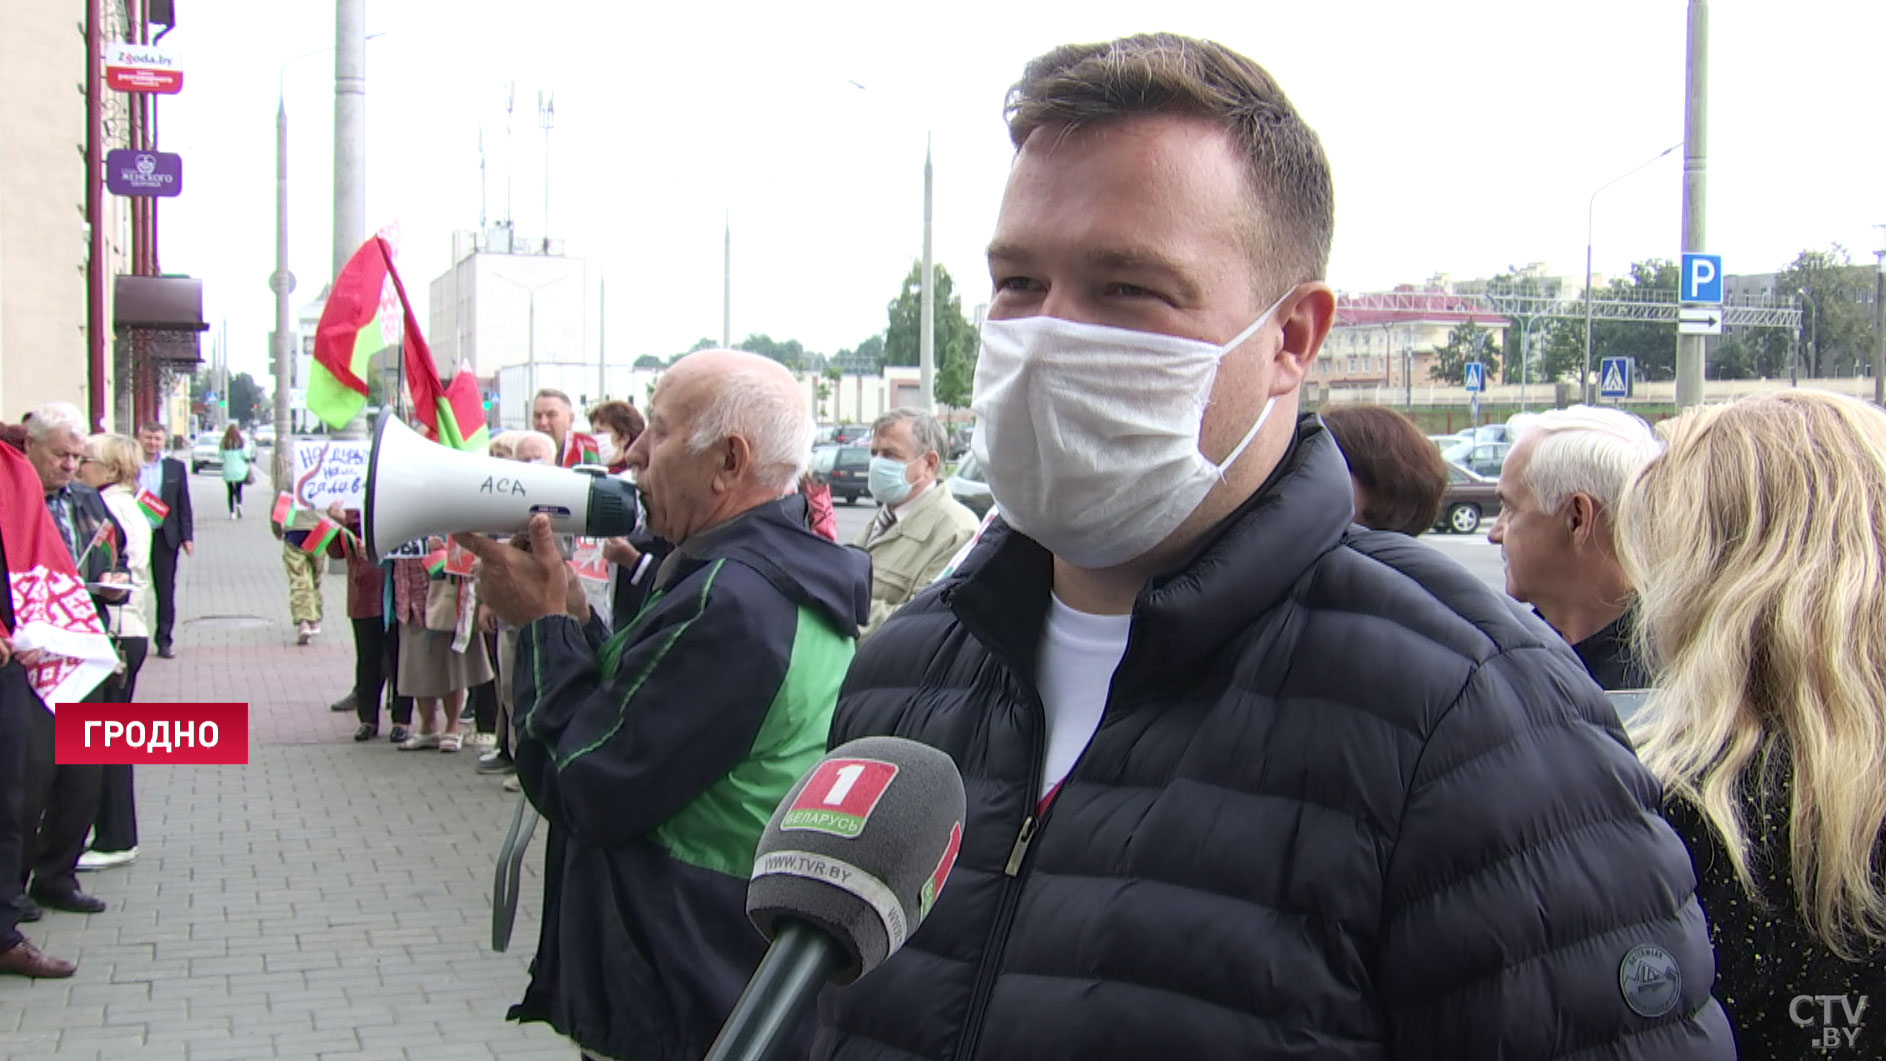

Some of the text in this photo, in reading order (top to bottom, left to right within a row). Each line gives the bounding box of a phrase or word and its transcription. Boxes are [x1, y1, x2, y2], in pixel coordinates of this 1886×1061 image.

[1691, 258, 1716, 298] P
[822, 764, 866, 806] 1
[785, 811, 858, 832] БЕЛАРУСЬ
